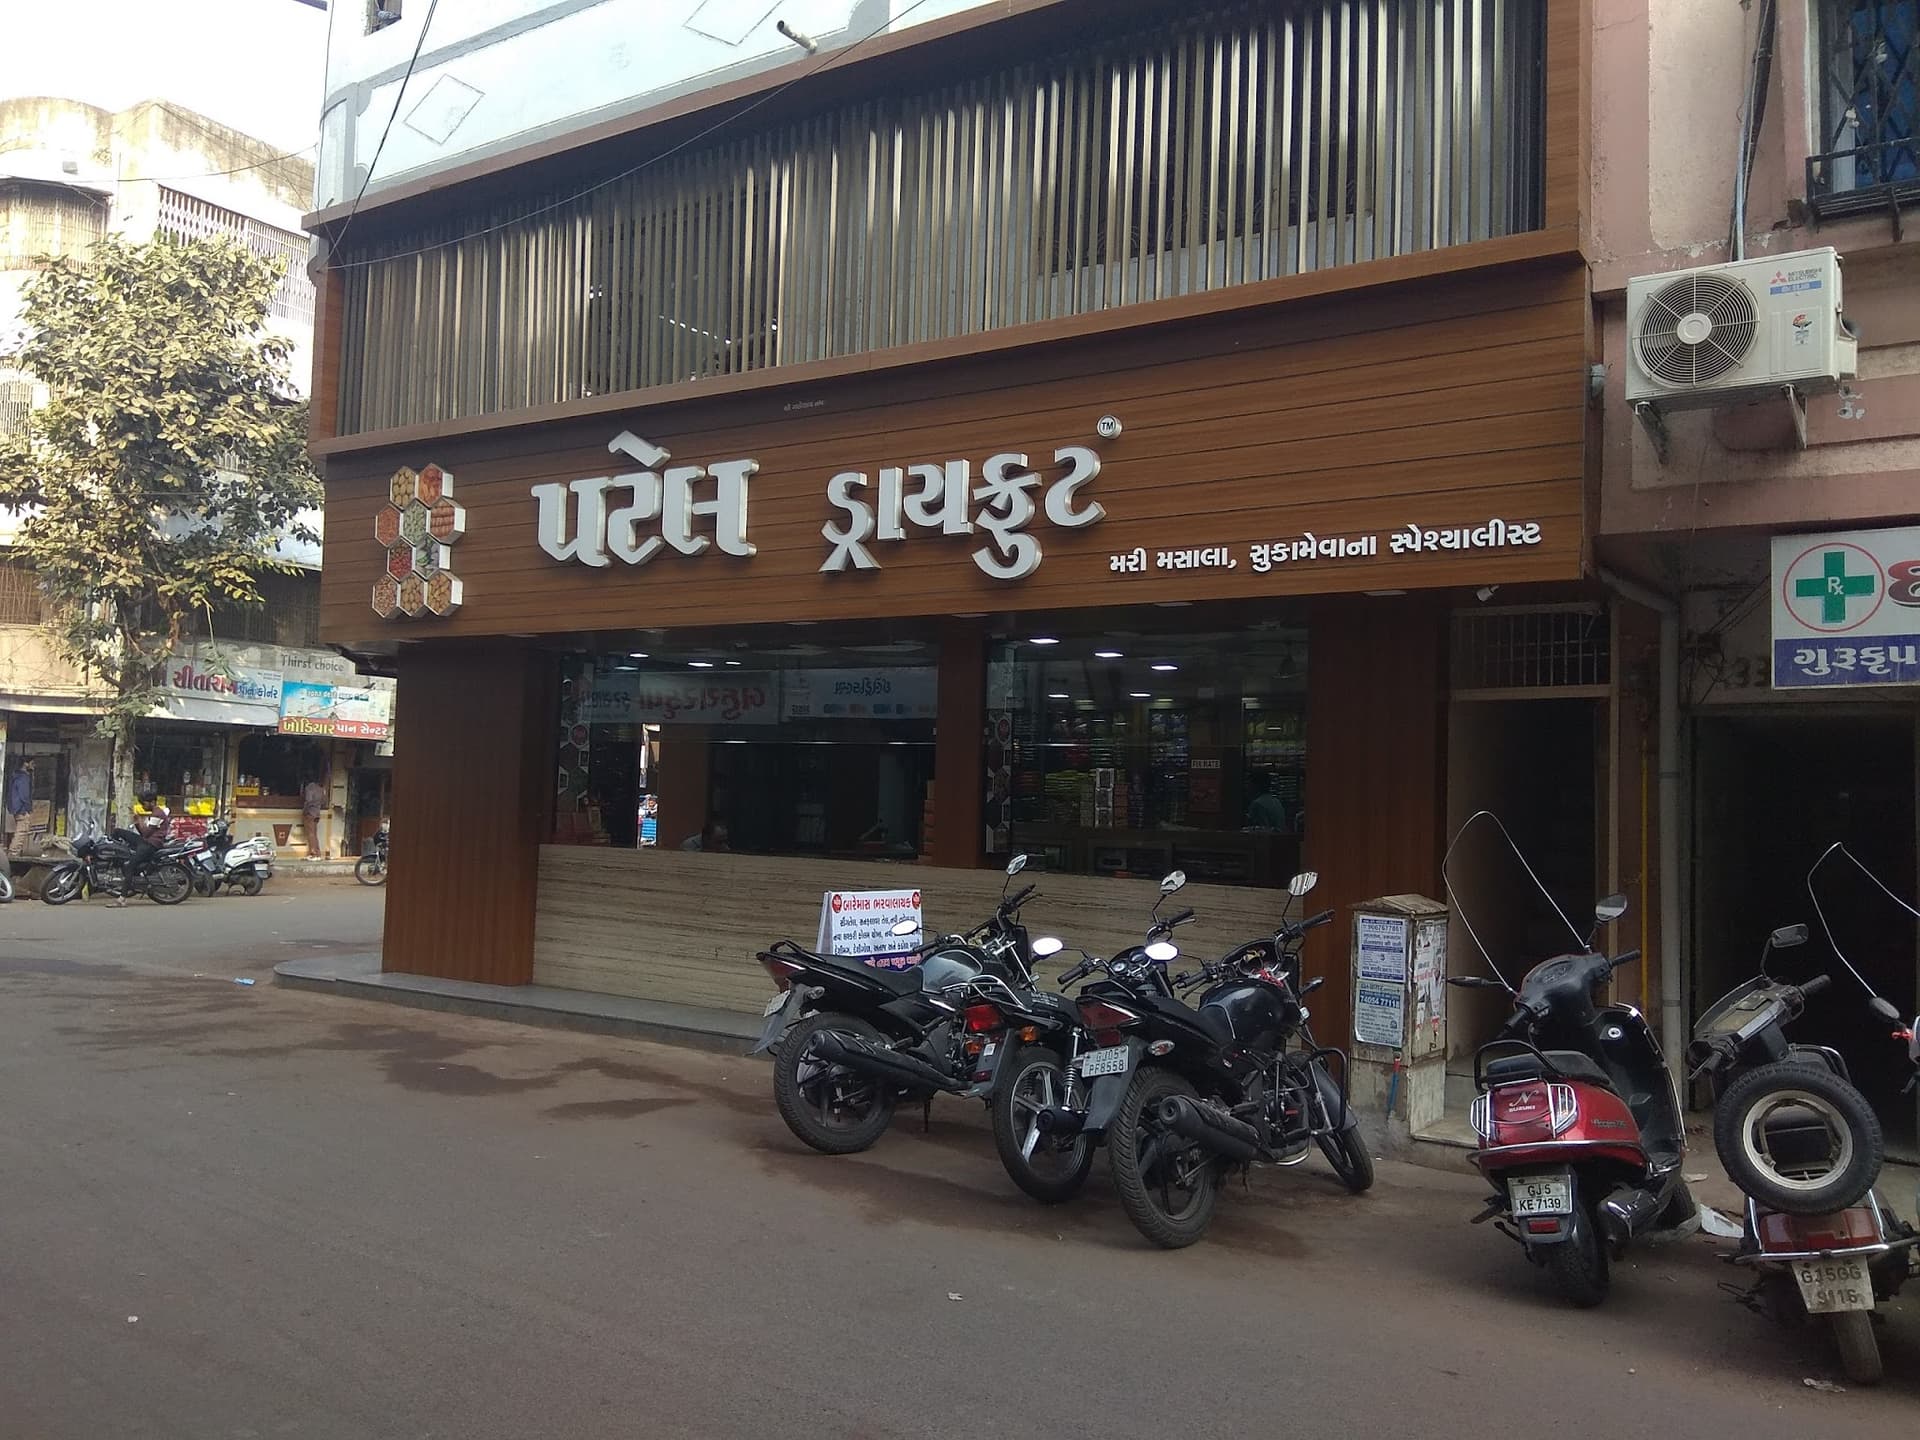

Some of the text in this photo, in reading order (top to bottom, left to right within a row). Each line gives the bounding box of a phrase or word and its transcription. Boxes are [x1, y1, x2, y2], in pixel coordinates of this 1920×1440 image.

[530, 430, 760, 568] પટેલ
[1109, 547, 1147, 573] મરી
[1156, 546, 1237, 570] મસાલા,
[1249, 532, 1377, 573] સુકામેવાના
[314, 658, 345, 672] choice
[283, 718, 388, 736] ખોડિયાર પાન સેન્ટર
[1096, 1048, 1119, 1063] GJ05
[1089, 1059, 1124, 1075] PF8558
[1508, 1105, 1536, 1113] SUZUKI
